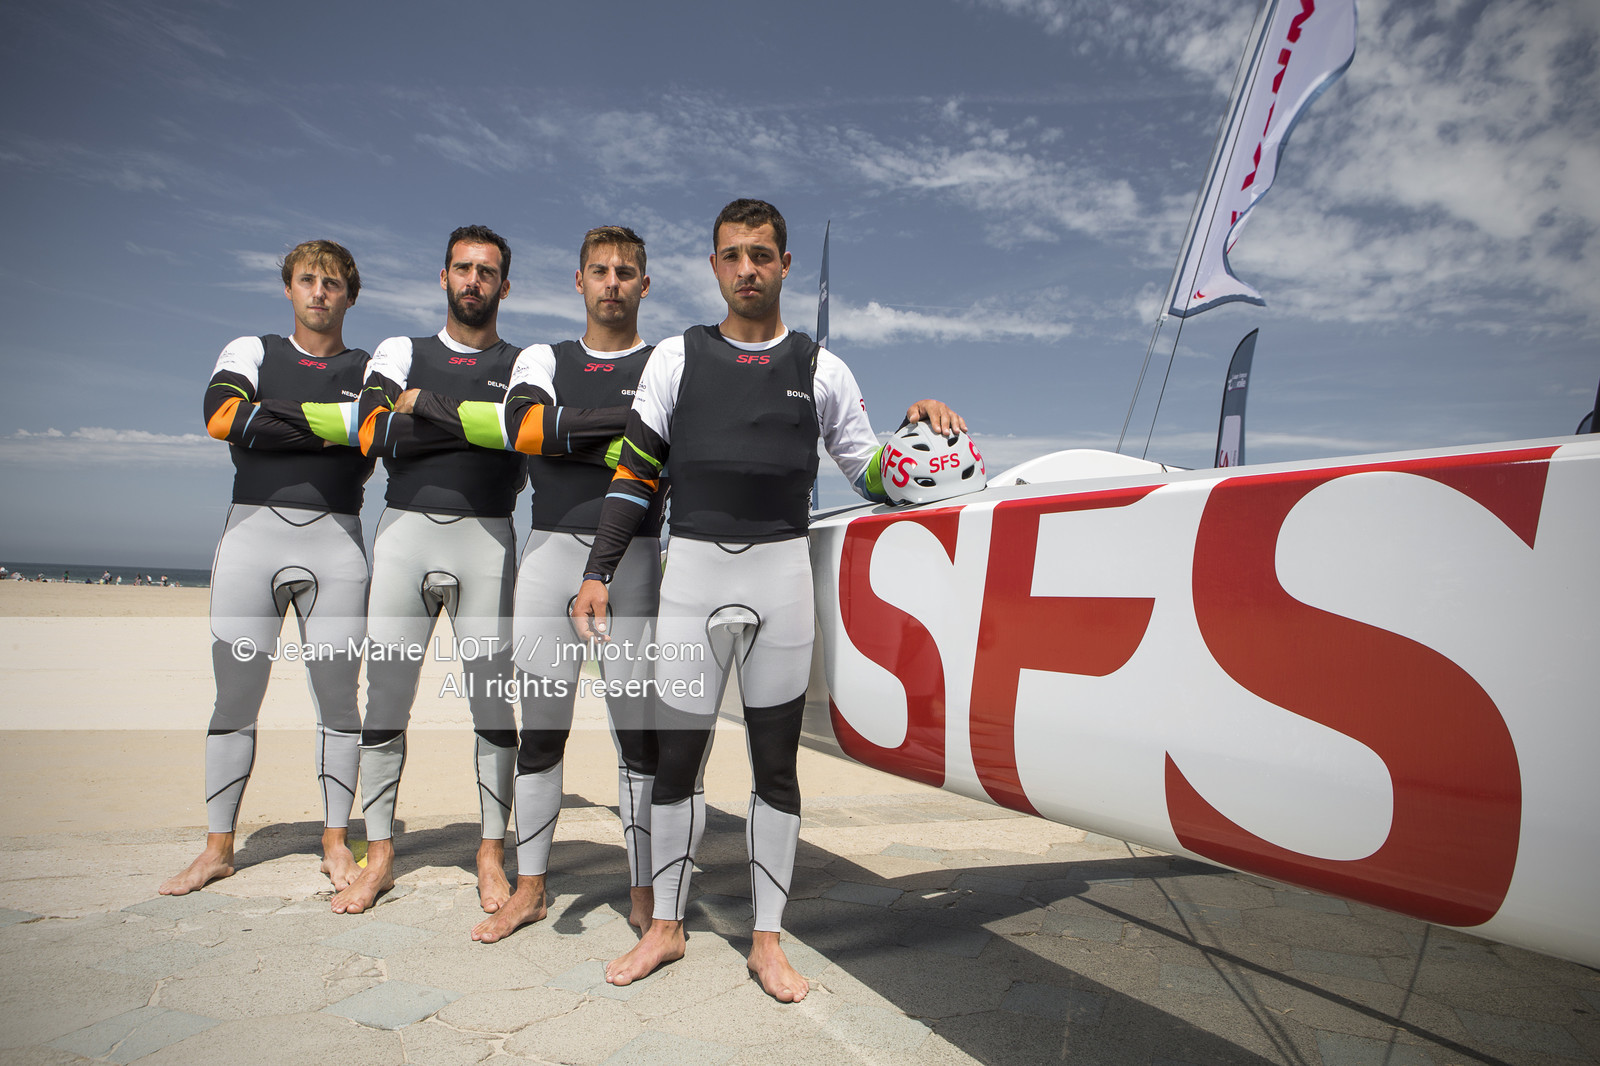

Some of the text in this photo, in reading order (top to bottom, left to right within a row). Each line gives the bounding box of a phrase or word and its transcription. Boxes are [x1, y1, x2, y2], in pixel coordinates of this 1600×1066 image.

[297, 358, 328, 370] SFS
[448, 356, 477, 366] SFS
[736, 353, 771, 365] SFS
[583, 362, 616, 372] SFS
[881, 444, 918, 488] SFS
[929, 452, 960, 474] SFS
[829, 445, 1562, 927] SFS
